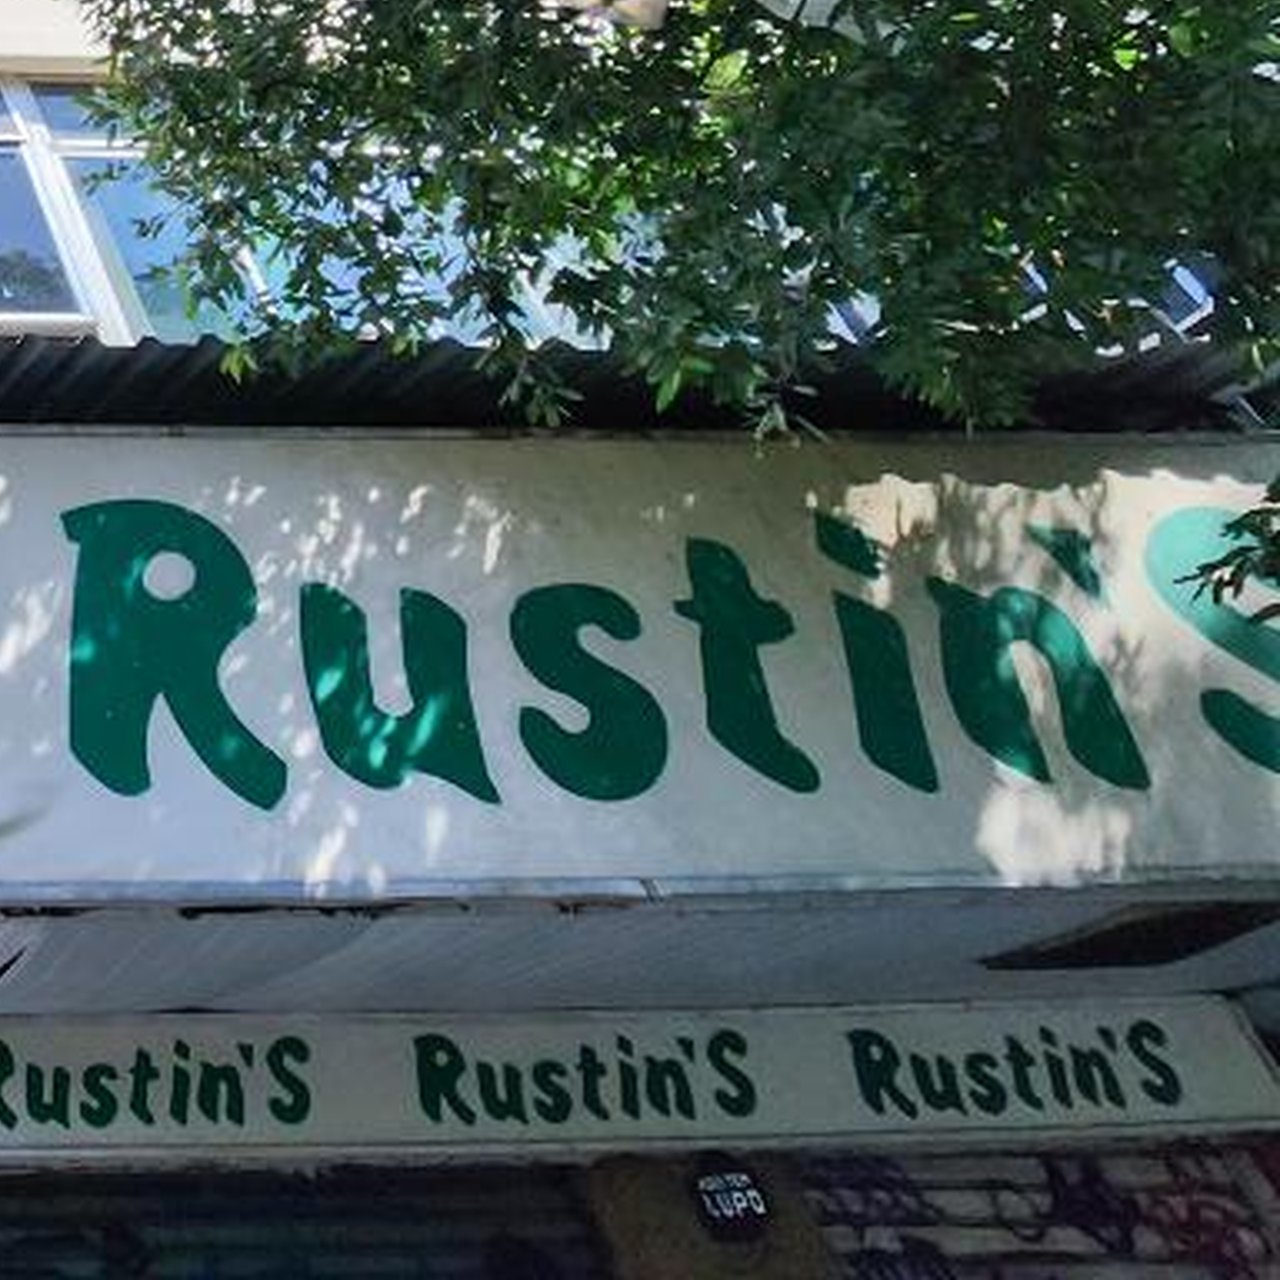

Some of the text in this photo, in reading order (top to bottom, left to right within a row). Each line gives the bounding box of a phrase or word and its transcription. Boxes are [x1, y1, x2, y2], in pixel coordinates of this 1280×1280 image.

[412, 1029, 757, 1126] Rustin'S
[845, 1019, 1182, 1119] Rustin'S
[701, 1188, 767, 1218] LUPO
